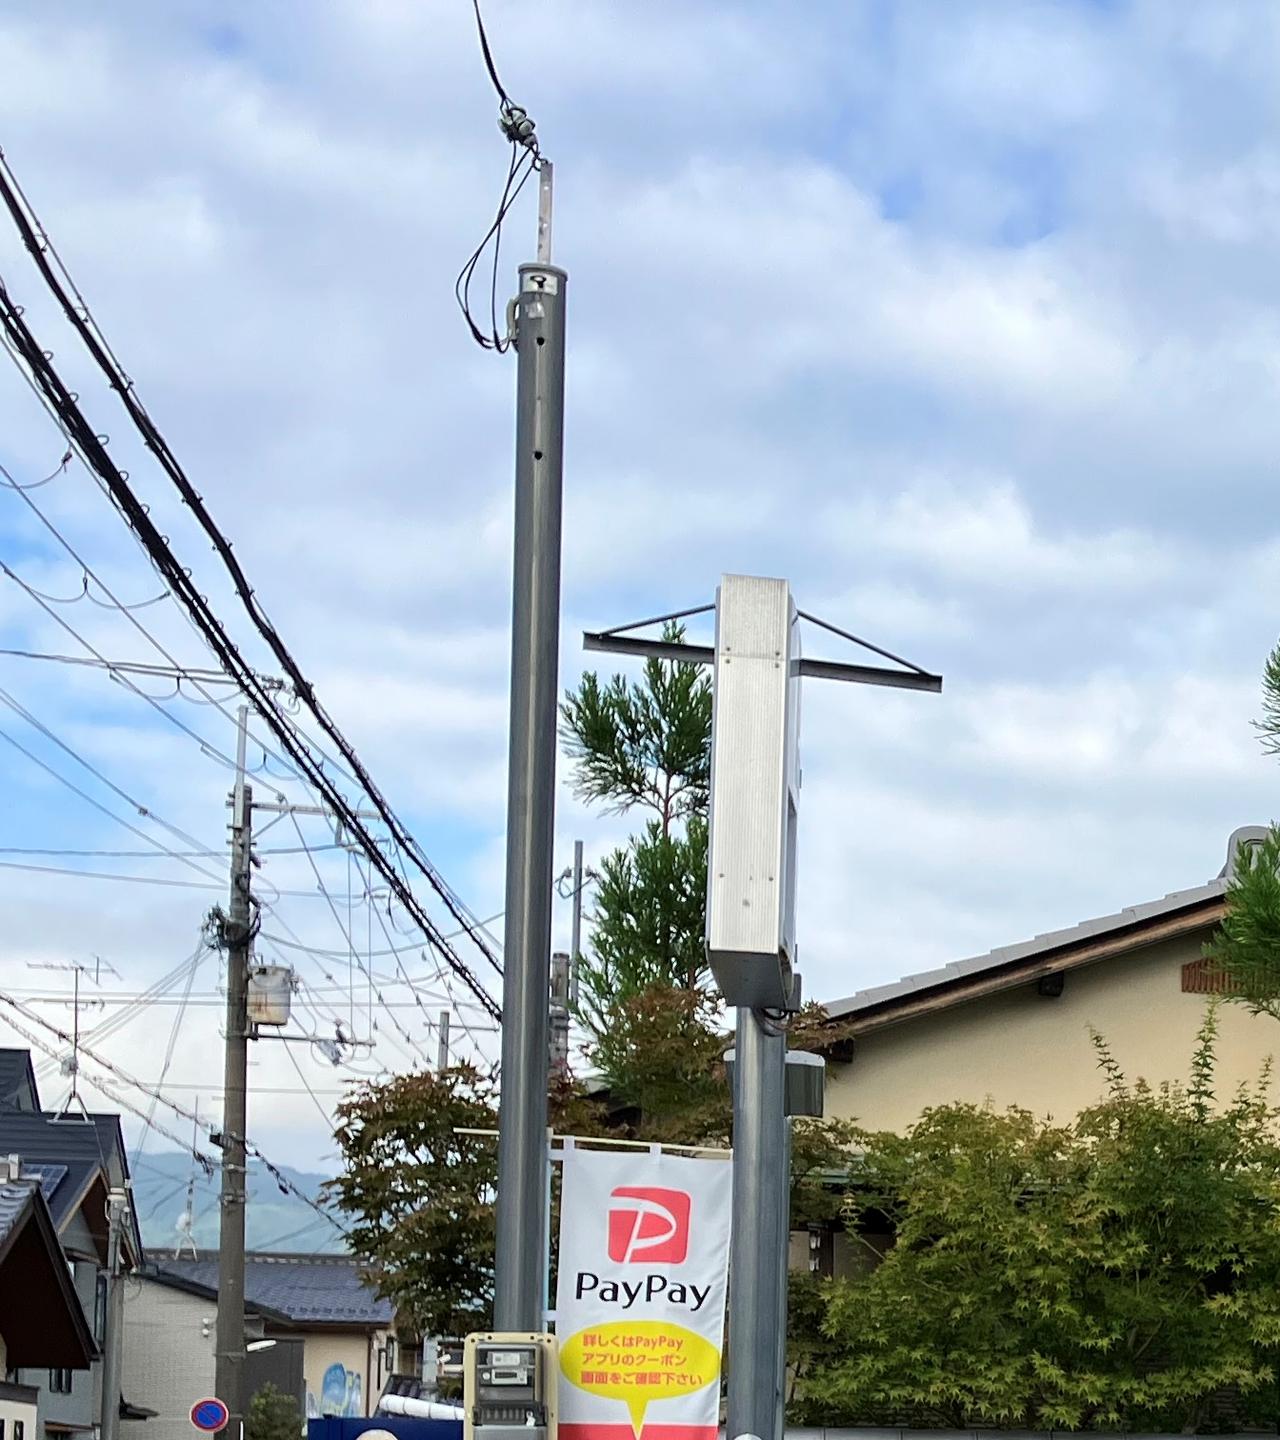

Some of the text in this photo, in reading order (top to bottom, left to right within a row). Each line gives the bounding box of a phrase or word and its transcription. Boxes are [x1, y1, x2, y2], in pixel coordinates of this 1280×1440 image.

[576, 1272, 711, 1311] PayPay
[583, 1333, 683, 1350] 詳しくはPayPay
[582, 1352, 687, 1366] アプリのクーポン
[581, 1371, 703, 1385] 画面をご確認下さい
